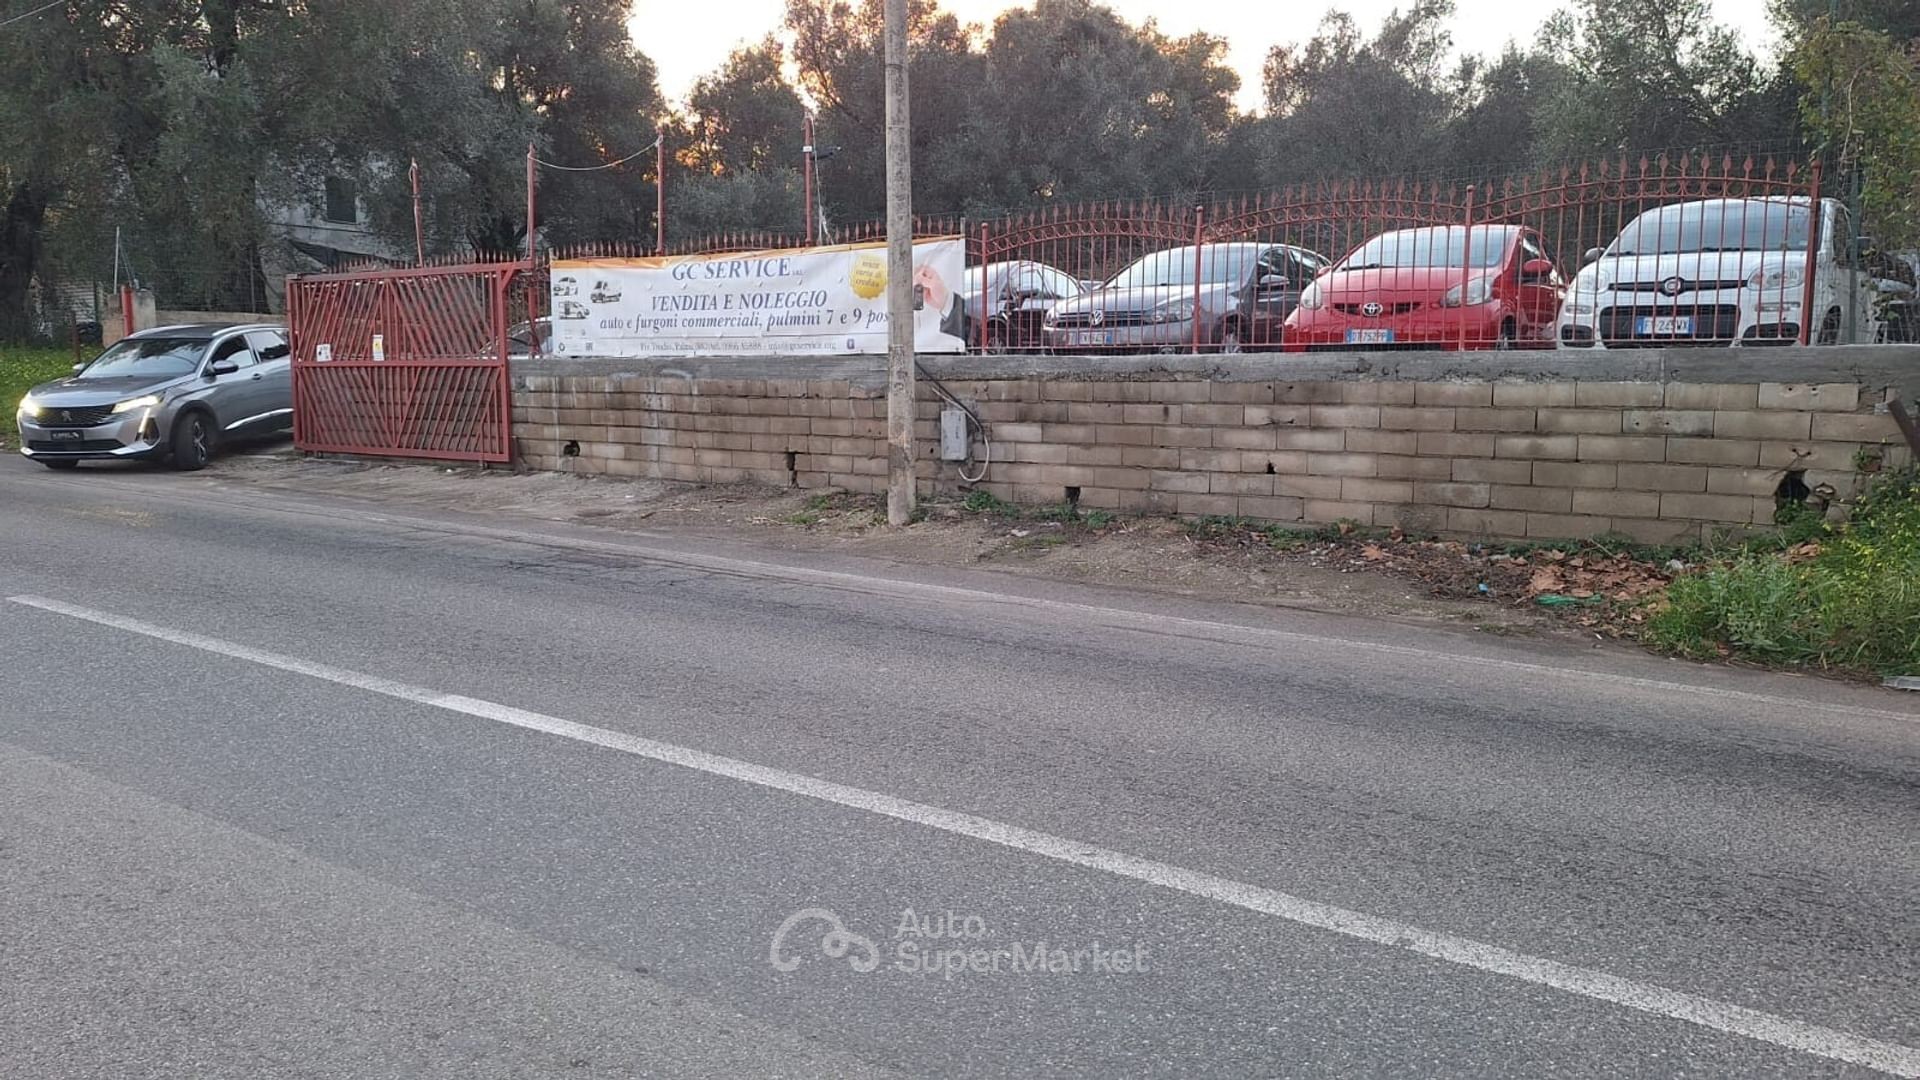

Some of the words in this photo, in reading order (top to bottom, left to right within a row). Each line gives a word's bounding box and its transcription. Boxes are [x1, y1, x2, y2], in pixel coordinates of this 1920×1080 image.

[672, 262, 697, 281] GC
[703, 257, 791, 281] SERVICE
[652, 293, 718, 312] VENDITA
[723, 293, 735, 310] E
[739, 290, 827, 311] NOLEGGIO
[600, 316, 624, 329] auto
[626, 319, 632, 329] e
[634, 313, 678, 335] furgoni
[767, 309, 821, 332] pulmini
[827, 309, 834, 325] 7
[840, 314, 847, 325] e
[853, 310, 862, 323] 9
[866, 310, 888, 329] pos
